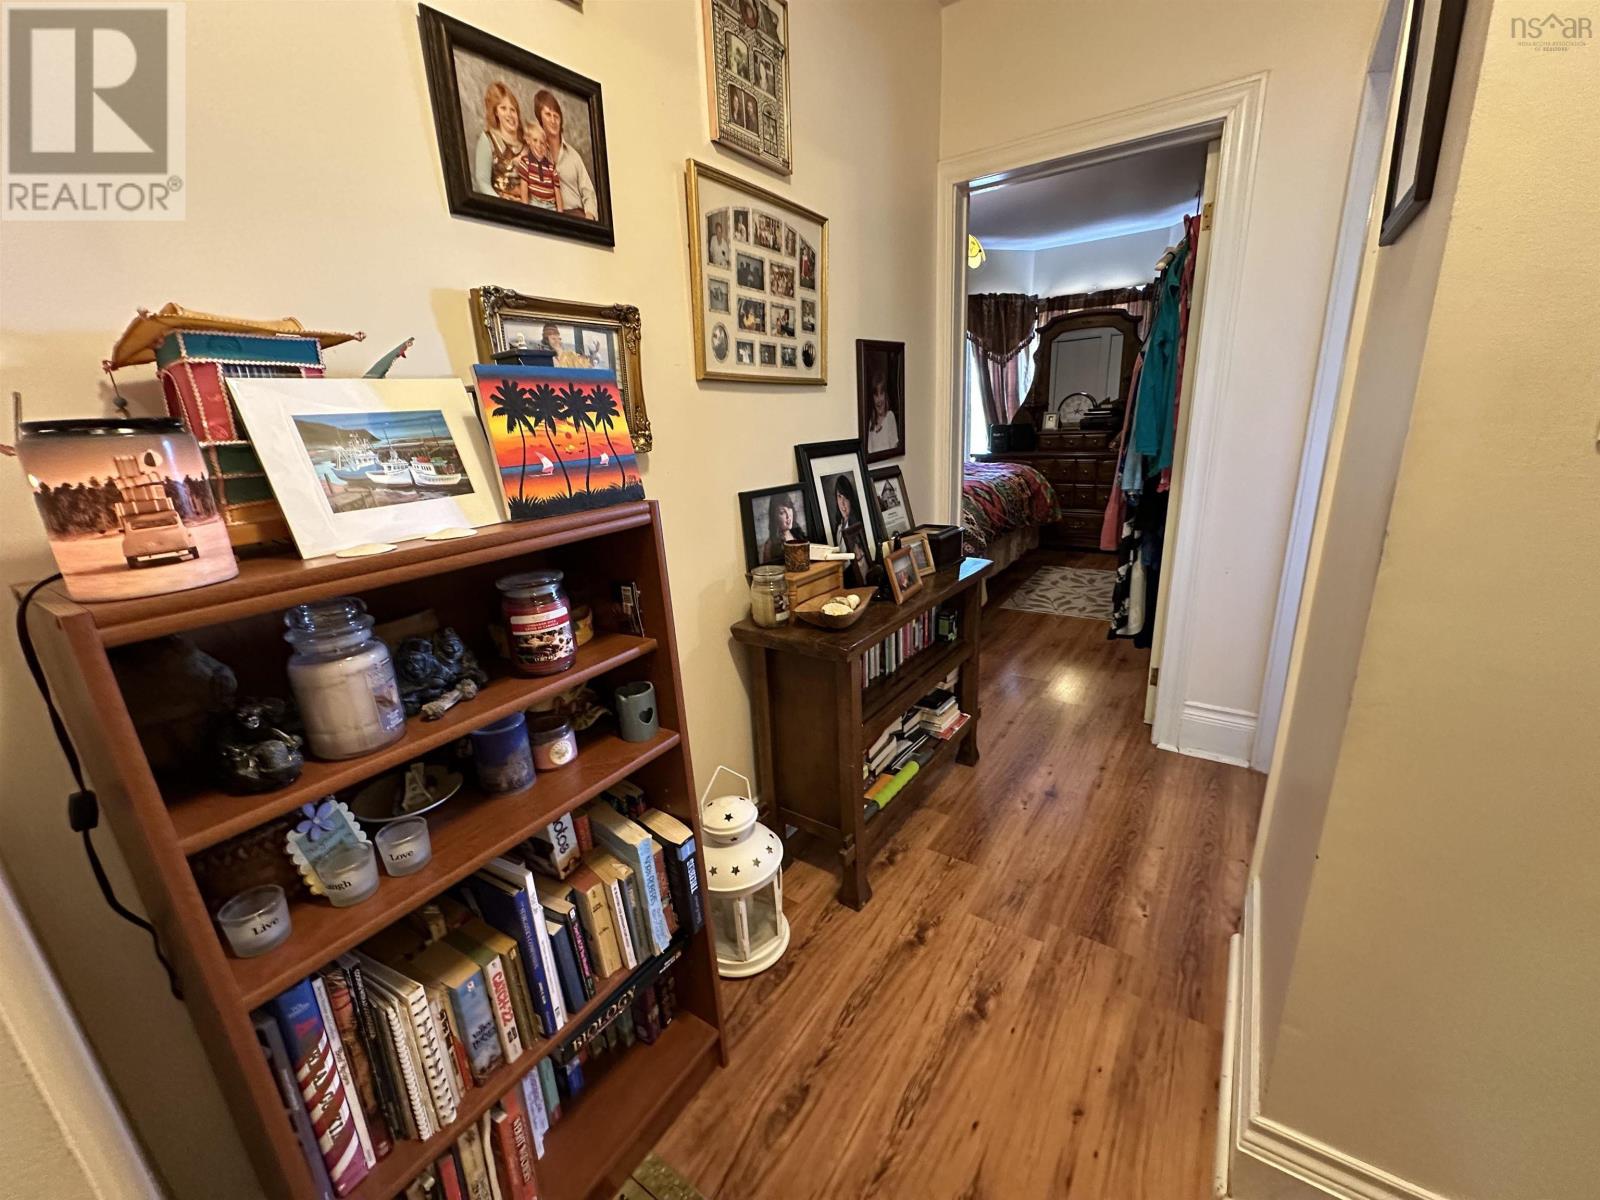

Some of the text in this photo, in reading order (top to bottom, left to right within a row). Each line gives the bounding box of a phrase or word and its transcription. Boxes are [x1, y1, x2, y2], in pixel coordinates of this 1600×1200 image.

[388, 849, 415, 863] Love
[251, 916, 280, 937] Live
[572, 984, 636, 1053] BIOLOGY
